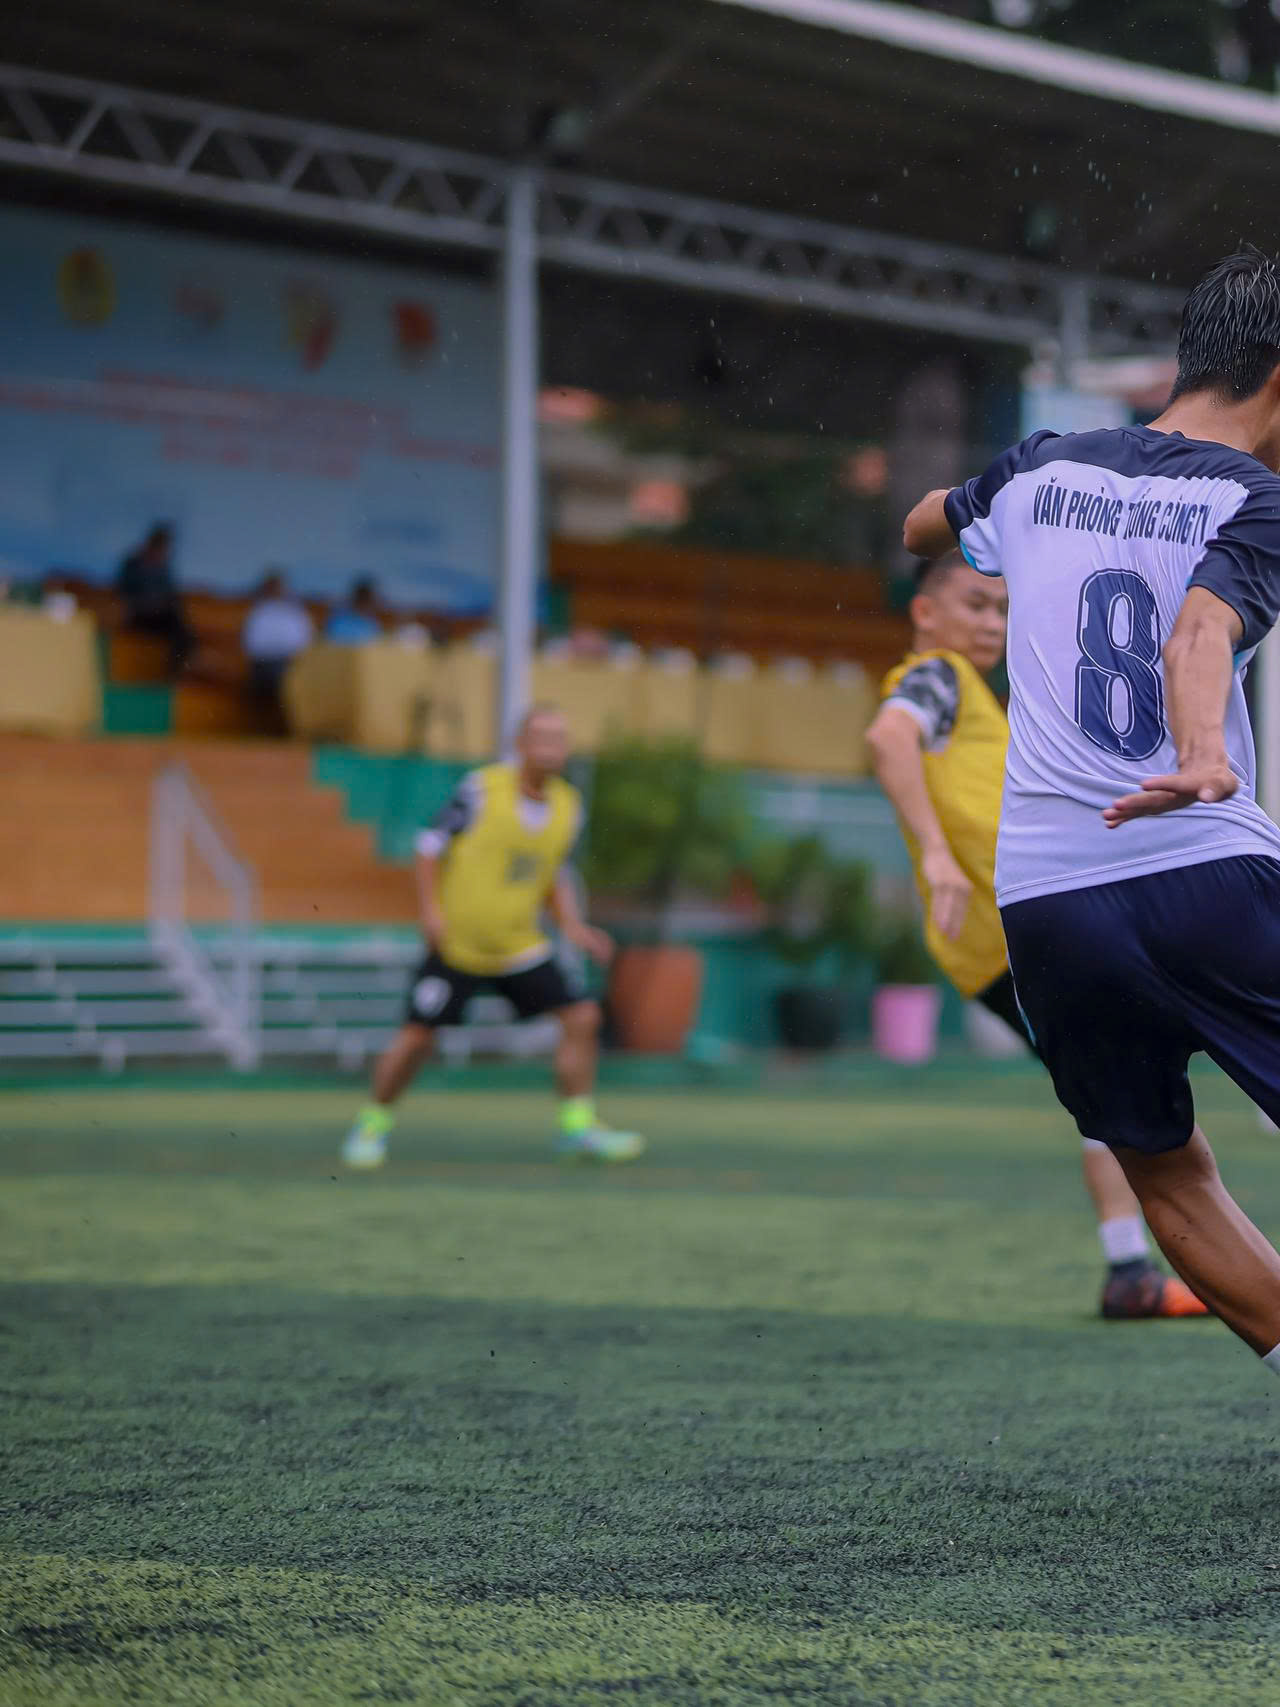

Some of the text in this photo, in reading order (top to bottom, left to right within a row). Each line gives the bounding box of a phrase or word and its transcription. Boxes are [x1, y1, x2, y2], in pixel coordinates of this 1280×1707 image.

[1033, 476, 1068, 527] VĂN
[1065, 487, 1123, 537] PHÒNG
[1075, 568, 1165, 761] 8
